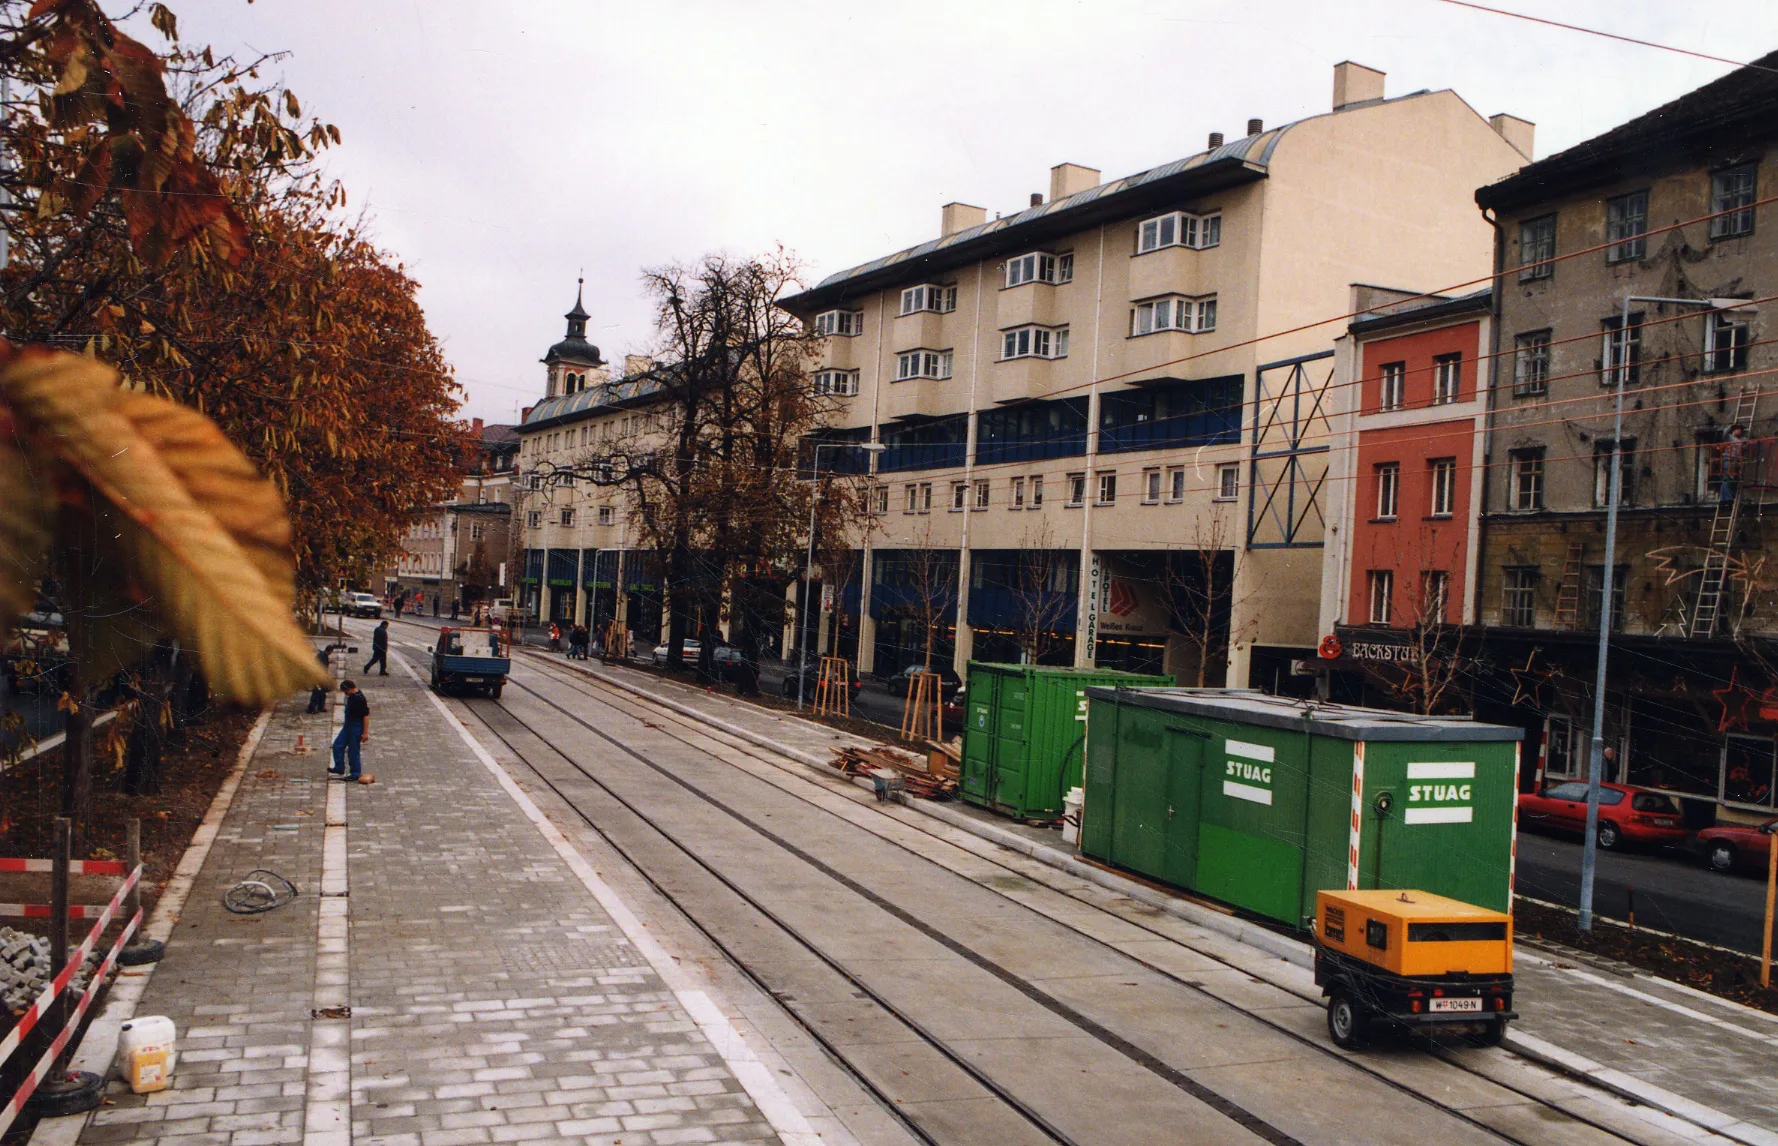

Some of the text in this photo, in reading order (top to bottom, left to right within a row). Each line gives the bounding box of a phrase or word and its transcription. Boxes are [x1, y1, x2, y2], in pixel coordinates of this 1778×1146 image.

[1102, 566, 1110, 613] LPOTEL
[1087, 557, 1099, 659] HOTEL GARAGE
[1226, 760, 1271, 784] STUAG
[1409, 784, 1471, 801] STUAG
